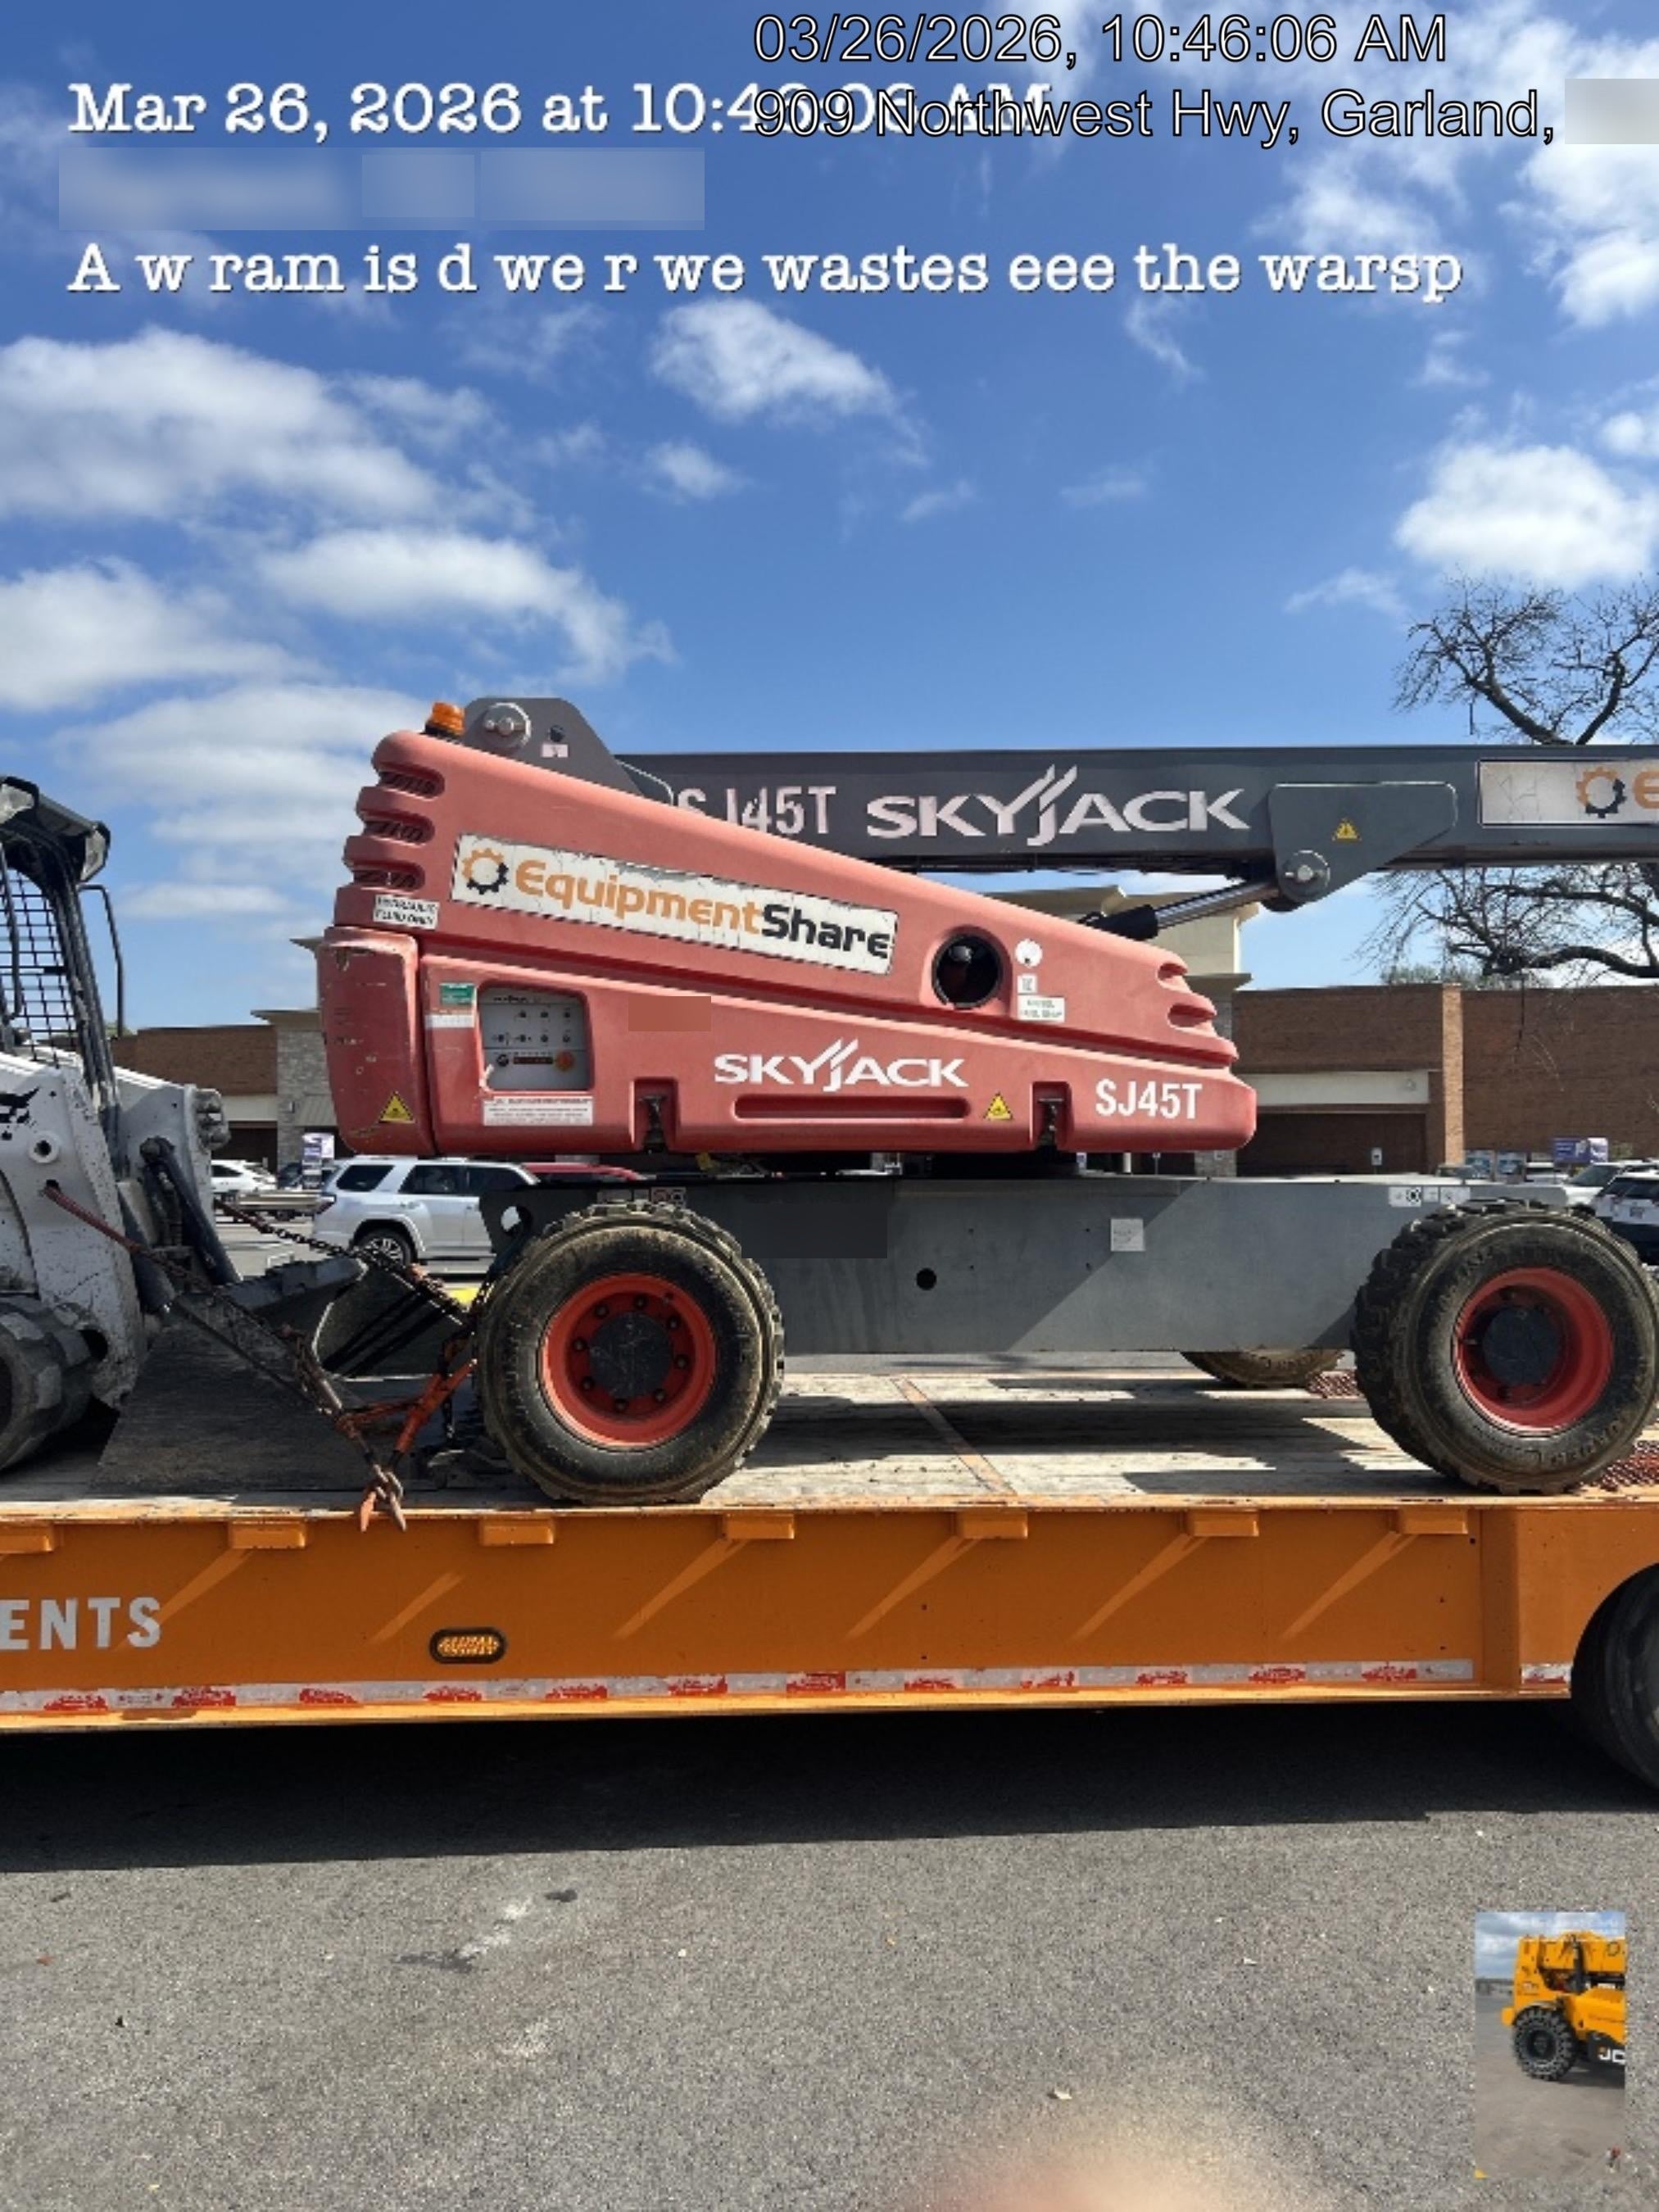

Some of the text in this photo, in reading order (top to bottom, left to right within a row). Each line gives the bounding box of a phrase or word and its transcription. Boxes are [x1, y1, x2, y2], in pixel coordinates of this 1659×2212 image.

[867, 764, 1250, 845] SKYJACK
[515, 860, 891, 958] EquipmentShare
[714, 1039, 968, 1092] SKYJACK
[1095, 1080, 1202, 1119] SJ45T
[0, 1597, 161, 1650] ENTS
